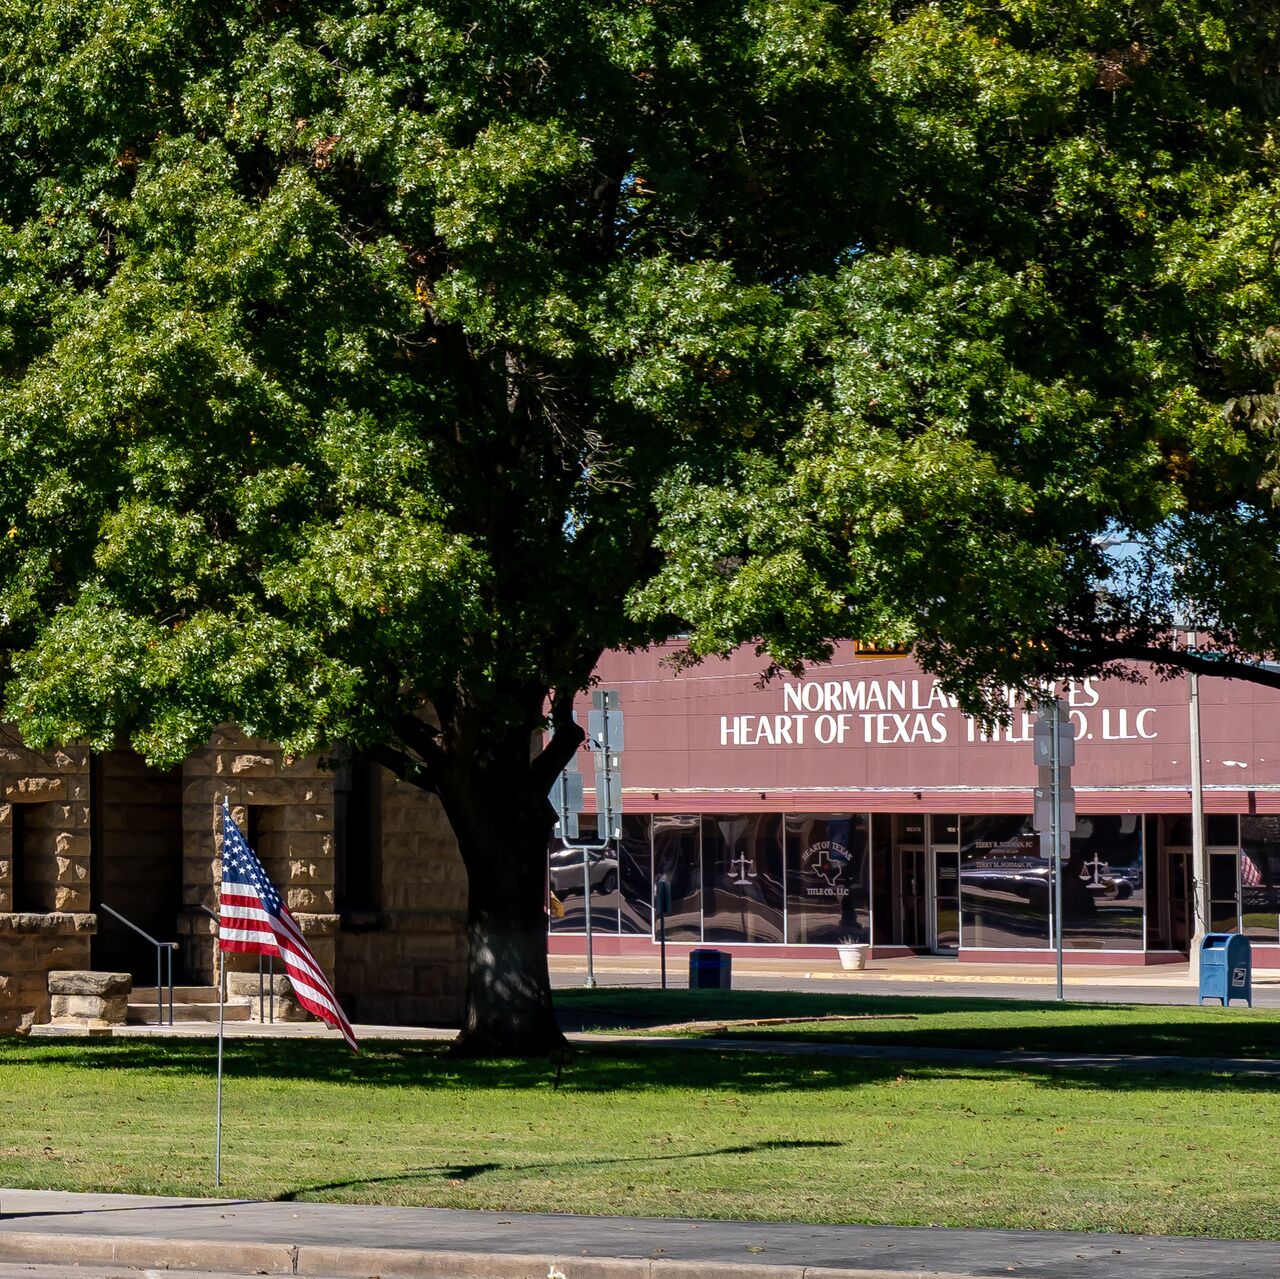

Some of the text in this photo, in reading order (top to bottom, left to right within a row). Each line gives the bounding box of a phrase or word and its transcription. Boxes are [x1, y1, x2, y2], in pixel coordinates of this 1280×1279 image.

[783, 680, 906, 712] NORMAN
[720, 715, 809, 746] HEART
[814, 713, 853, 744] OF
[859, 712, 948, 744] TEXAS
[1101, 708, 1158, 740] LLC
[801, 841, 853, 861] HEART OF TEXAS
